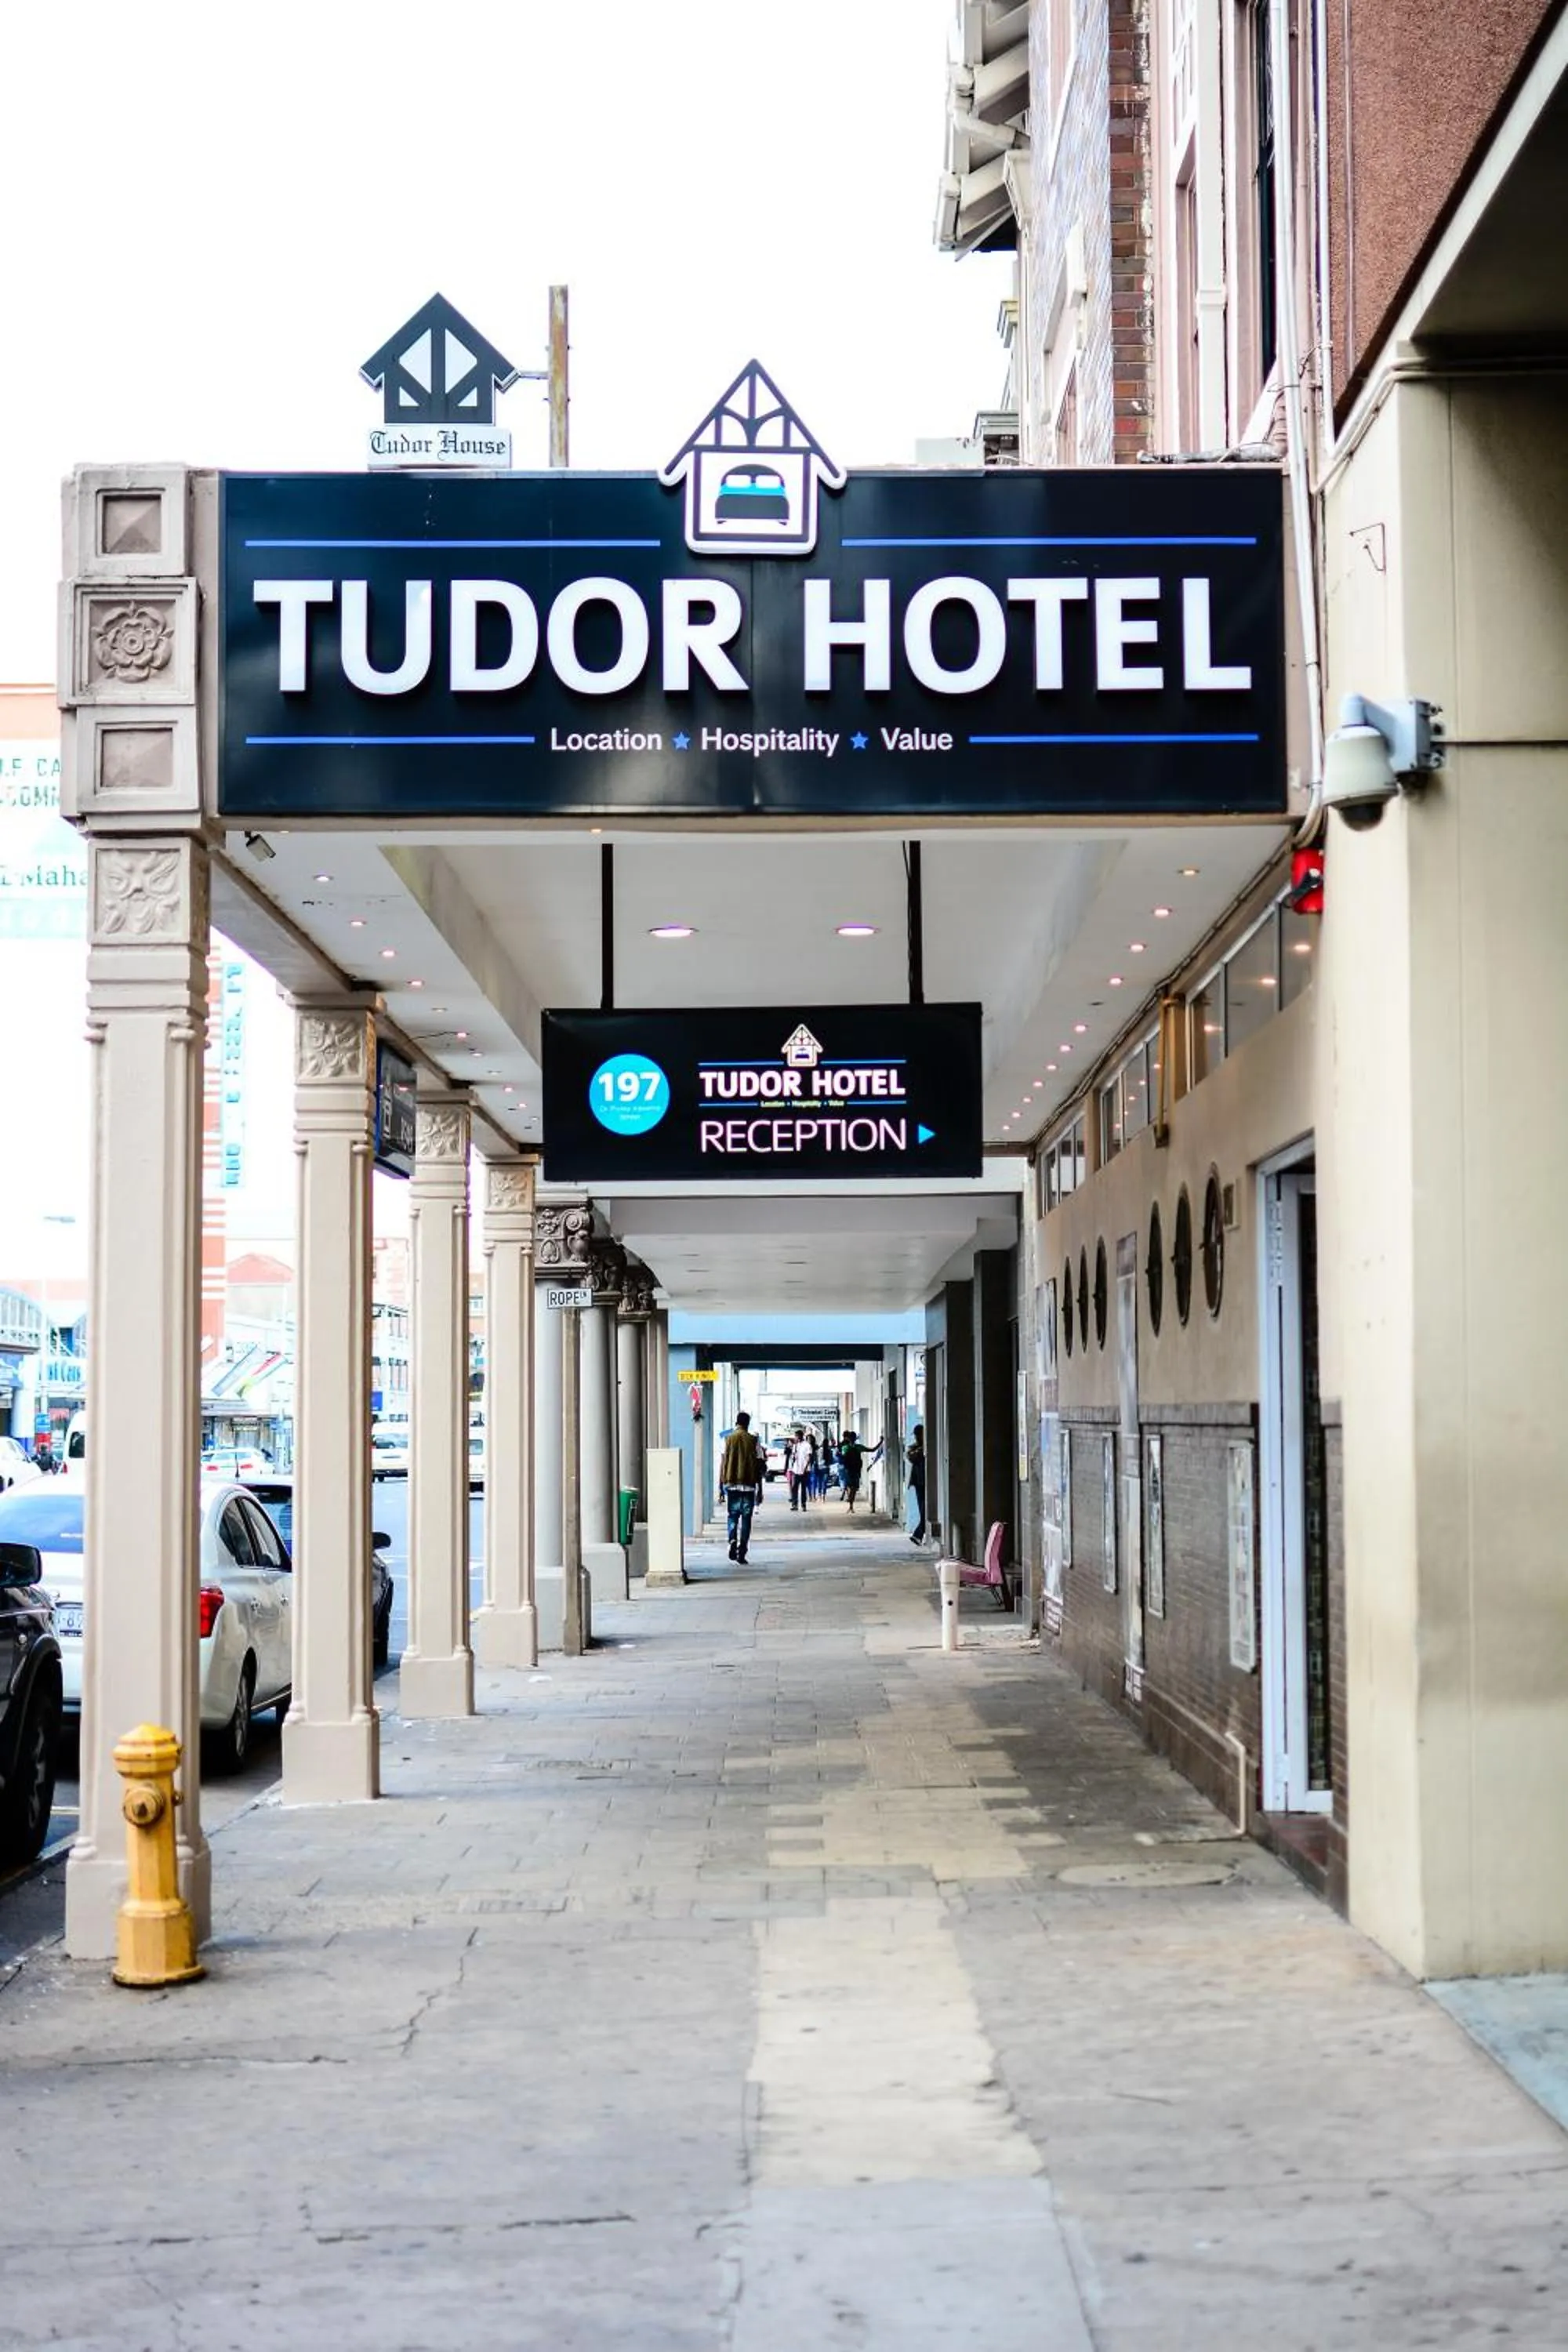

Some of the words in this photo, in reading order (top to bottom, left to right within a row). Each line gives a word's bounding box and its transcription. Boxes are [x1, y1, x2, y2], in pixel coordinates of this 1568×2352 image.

[370, 430, 433, 455] Tudor
[437, 430, 506, 461] House
[253, 577, 750, 695] TUDOR
[804, 576, 1252, 694] HOTEL
[550, 728, 662, 751] Location
[701, 727, 840, 757] Hospitality
[880, 727, 953, 750] Value
[598, 1072, 661, 1102] 197
[699, 1071, 802, 1097] TUDOR
[811, 1069, 906, 1096] HOTEL
[700, 1118, 907, 1152] RECEPTION
[550, 1291, 579, 1305] ROPE
